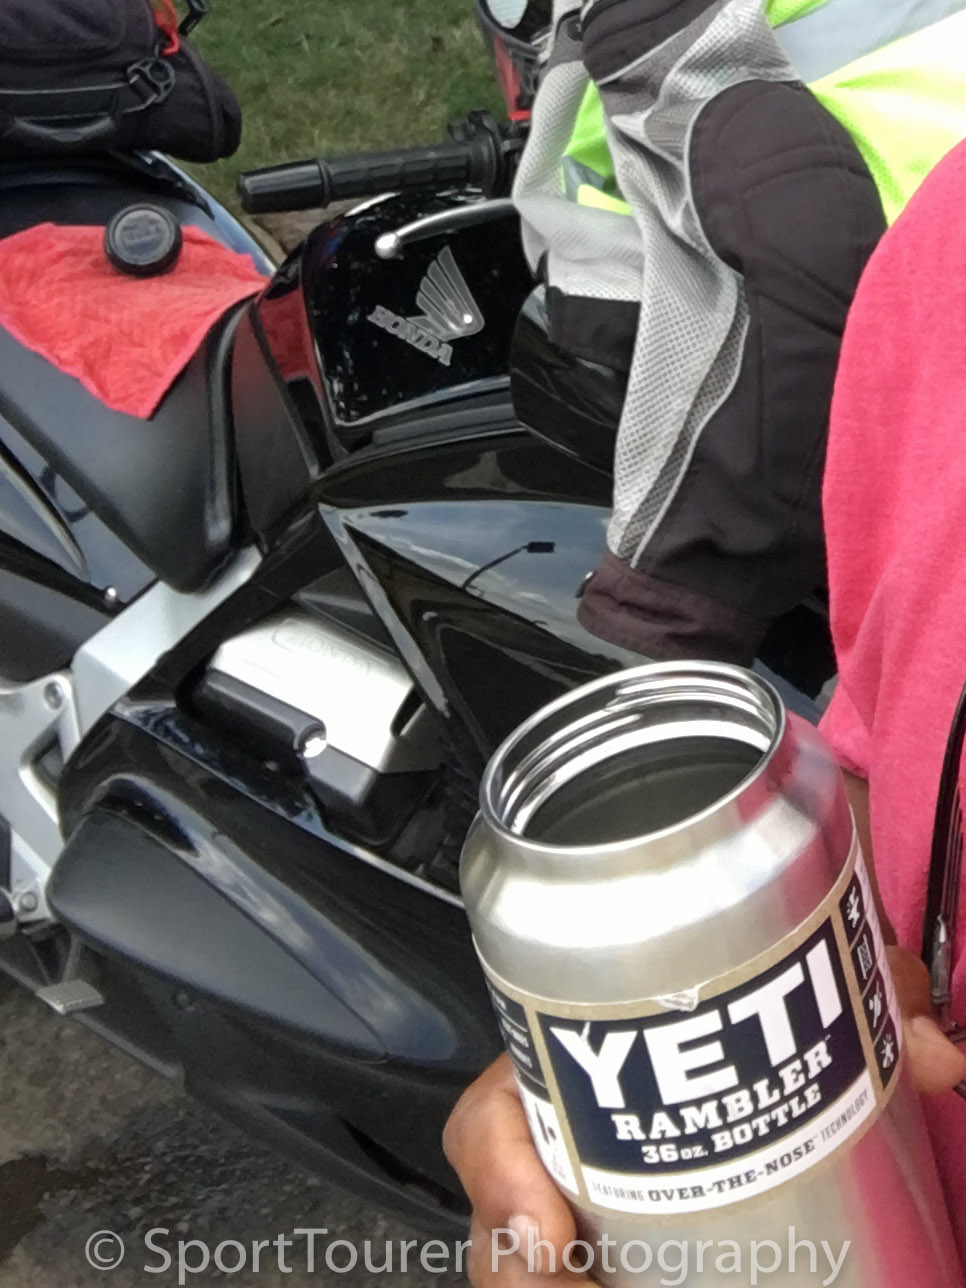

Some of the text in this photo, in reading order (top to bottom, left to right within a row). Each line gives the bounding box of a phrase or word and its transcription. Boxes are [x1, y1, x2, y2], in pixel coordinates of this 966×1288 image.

[367, 305, 452, 366] HONDA
[549, 938, 842, 1109] YETI
[611, 1041, 832, 1140] RAMBLER
[711, 1083, 821, 1152] BOTTLE
[648, 1139, 816, 1202] OVER-THE-NOSE
[820, 1088, 868, 1142] TECHNOLOGY
